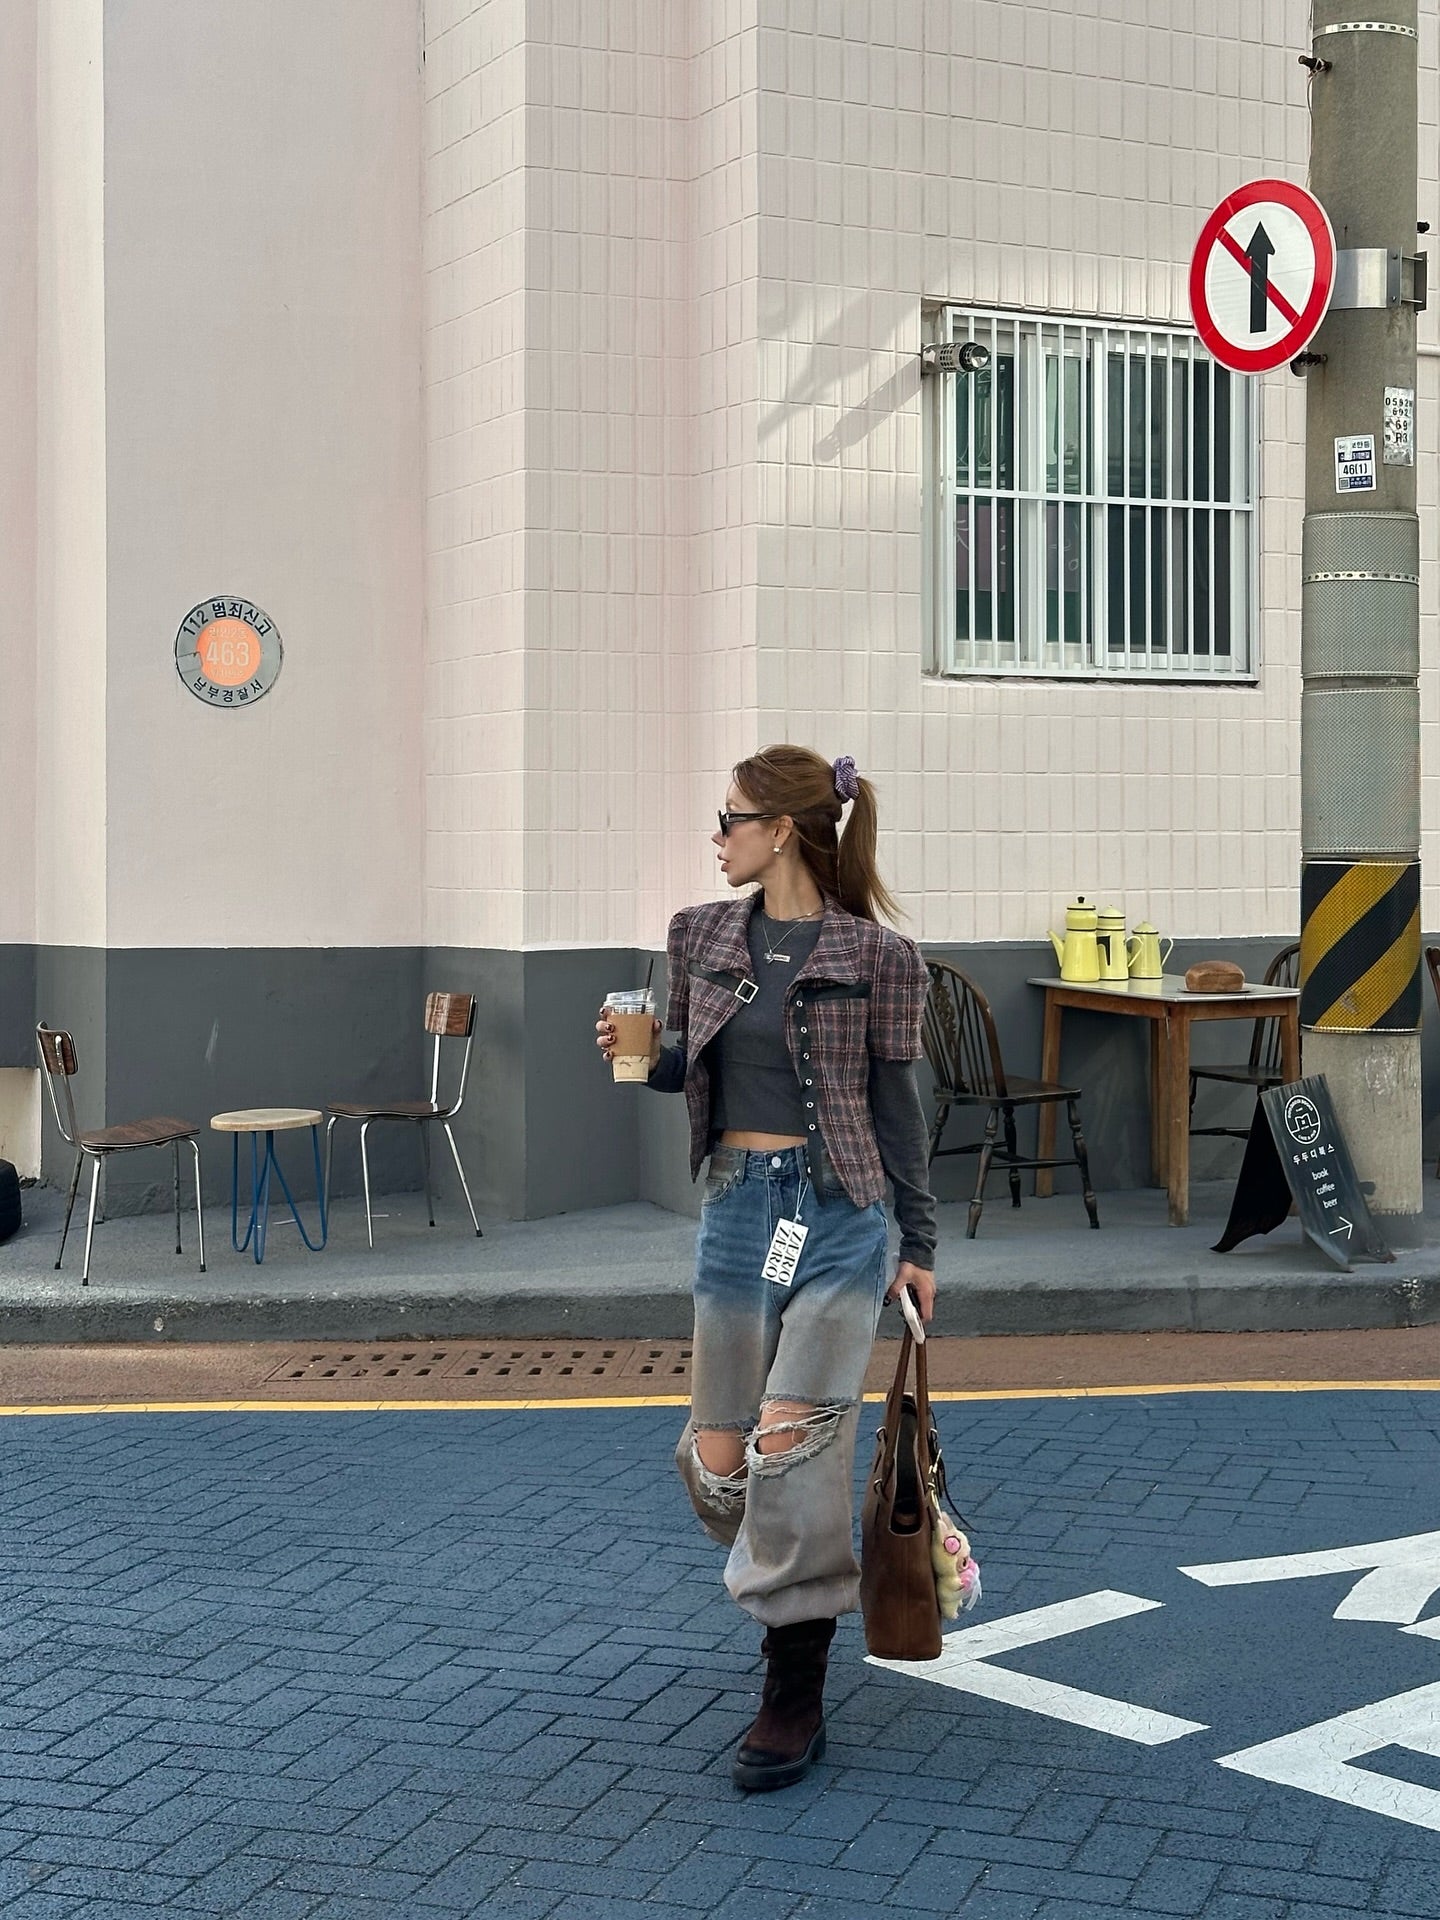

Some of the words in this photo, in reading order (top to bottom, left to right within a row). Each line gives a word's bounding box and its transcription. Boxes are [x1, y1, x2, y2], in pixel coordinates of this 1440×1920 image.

[1343, 463, 1367, 475] 46(1)
[183, 610, 208, 636] 112
[212, 601, 272, 637] 범죄신고
[206, 641, 249, 666] 463
[193, 677, 263, 703] 남부경찰서
[1311, 1167, 1329, 1180] book
[1316, 1183, 1335, 1195] coffee
[1322, 1198, 1338, 1209] beer
